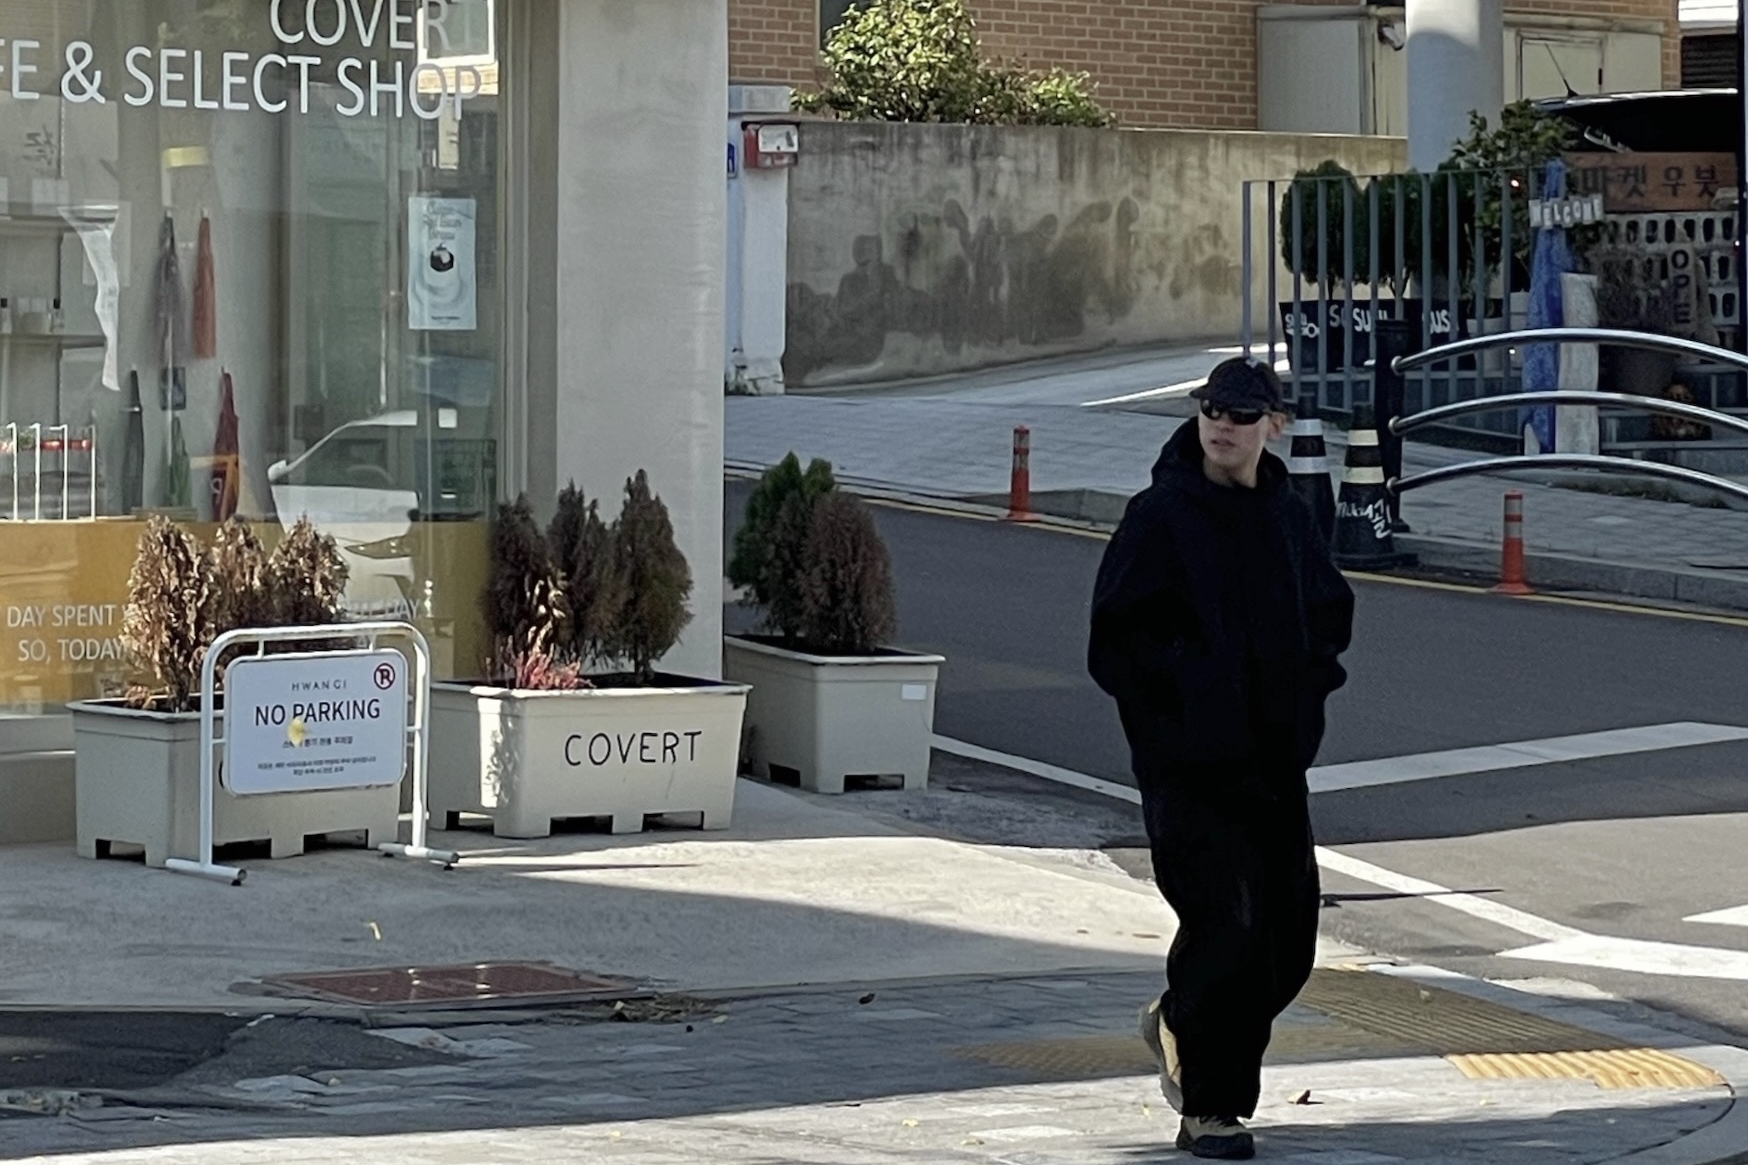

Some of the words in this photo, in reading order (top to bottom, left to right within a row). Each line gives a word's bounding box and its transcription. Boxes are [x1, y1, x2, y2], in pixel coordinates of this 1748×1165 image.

[61, 40, 106, 104] &
[124, 45, 321, 114] SELECT
[336, 57, 482, 121] SHOP
[7, 605, 46, 627] DAY
[52, 604, 117, 627] SPENT
[18, 639, 51, 664] SO,
[57, 638, 124, 661] TODAY
[255, 704, 286, 726] NO
[292, 698, 381, 724] PARKING
[564, 731, 703, 766] COVERT
